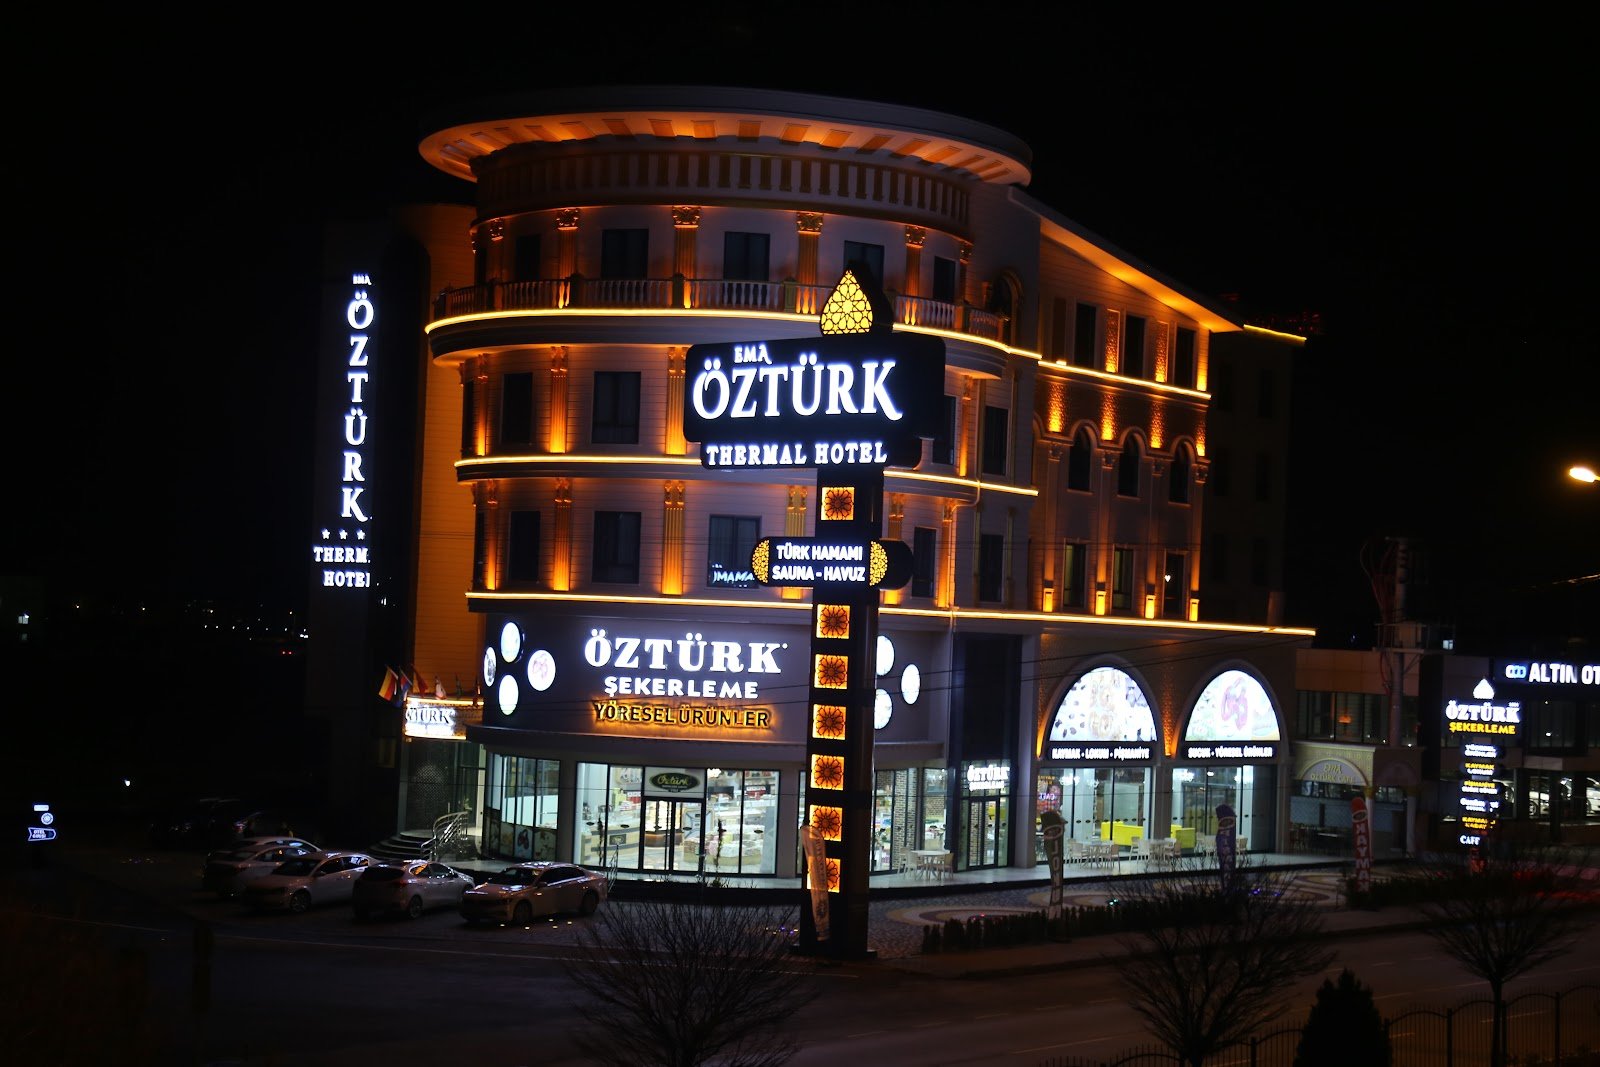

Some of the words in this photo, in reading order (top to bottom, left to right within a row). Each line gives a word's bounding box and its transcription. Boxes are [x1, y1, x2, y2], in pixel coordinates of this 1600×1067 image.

[734, 344, 772, 364] EMA
[692, 353, 903, 421] ÖZTÜRK
[706, 443, 807, 466] THERMAL
[814, 441, 888, 465] HOTEL
[776, 542, 810, 560] TÜRK
[811, 545, 863, 560] HAMAMI
[772, 565, 815, 580] SAUNA
[823, 566, 866, 581] HAVUZ
[584, 628, 783, 674] ÖZTÜRK
[1528, 662, 1578, 684] ALTIN
[604, 676, 758, 699] ŞEKERLEME
[594, 700, 676, 724] YÖRESEL
[679, 704, 770, 728] ÜRÜNLER
[1445, 700, 1520, 723] ÖZTÜRK
[1449, 721, 1516, 735] ŞEKERLEME
